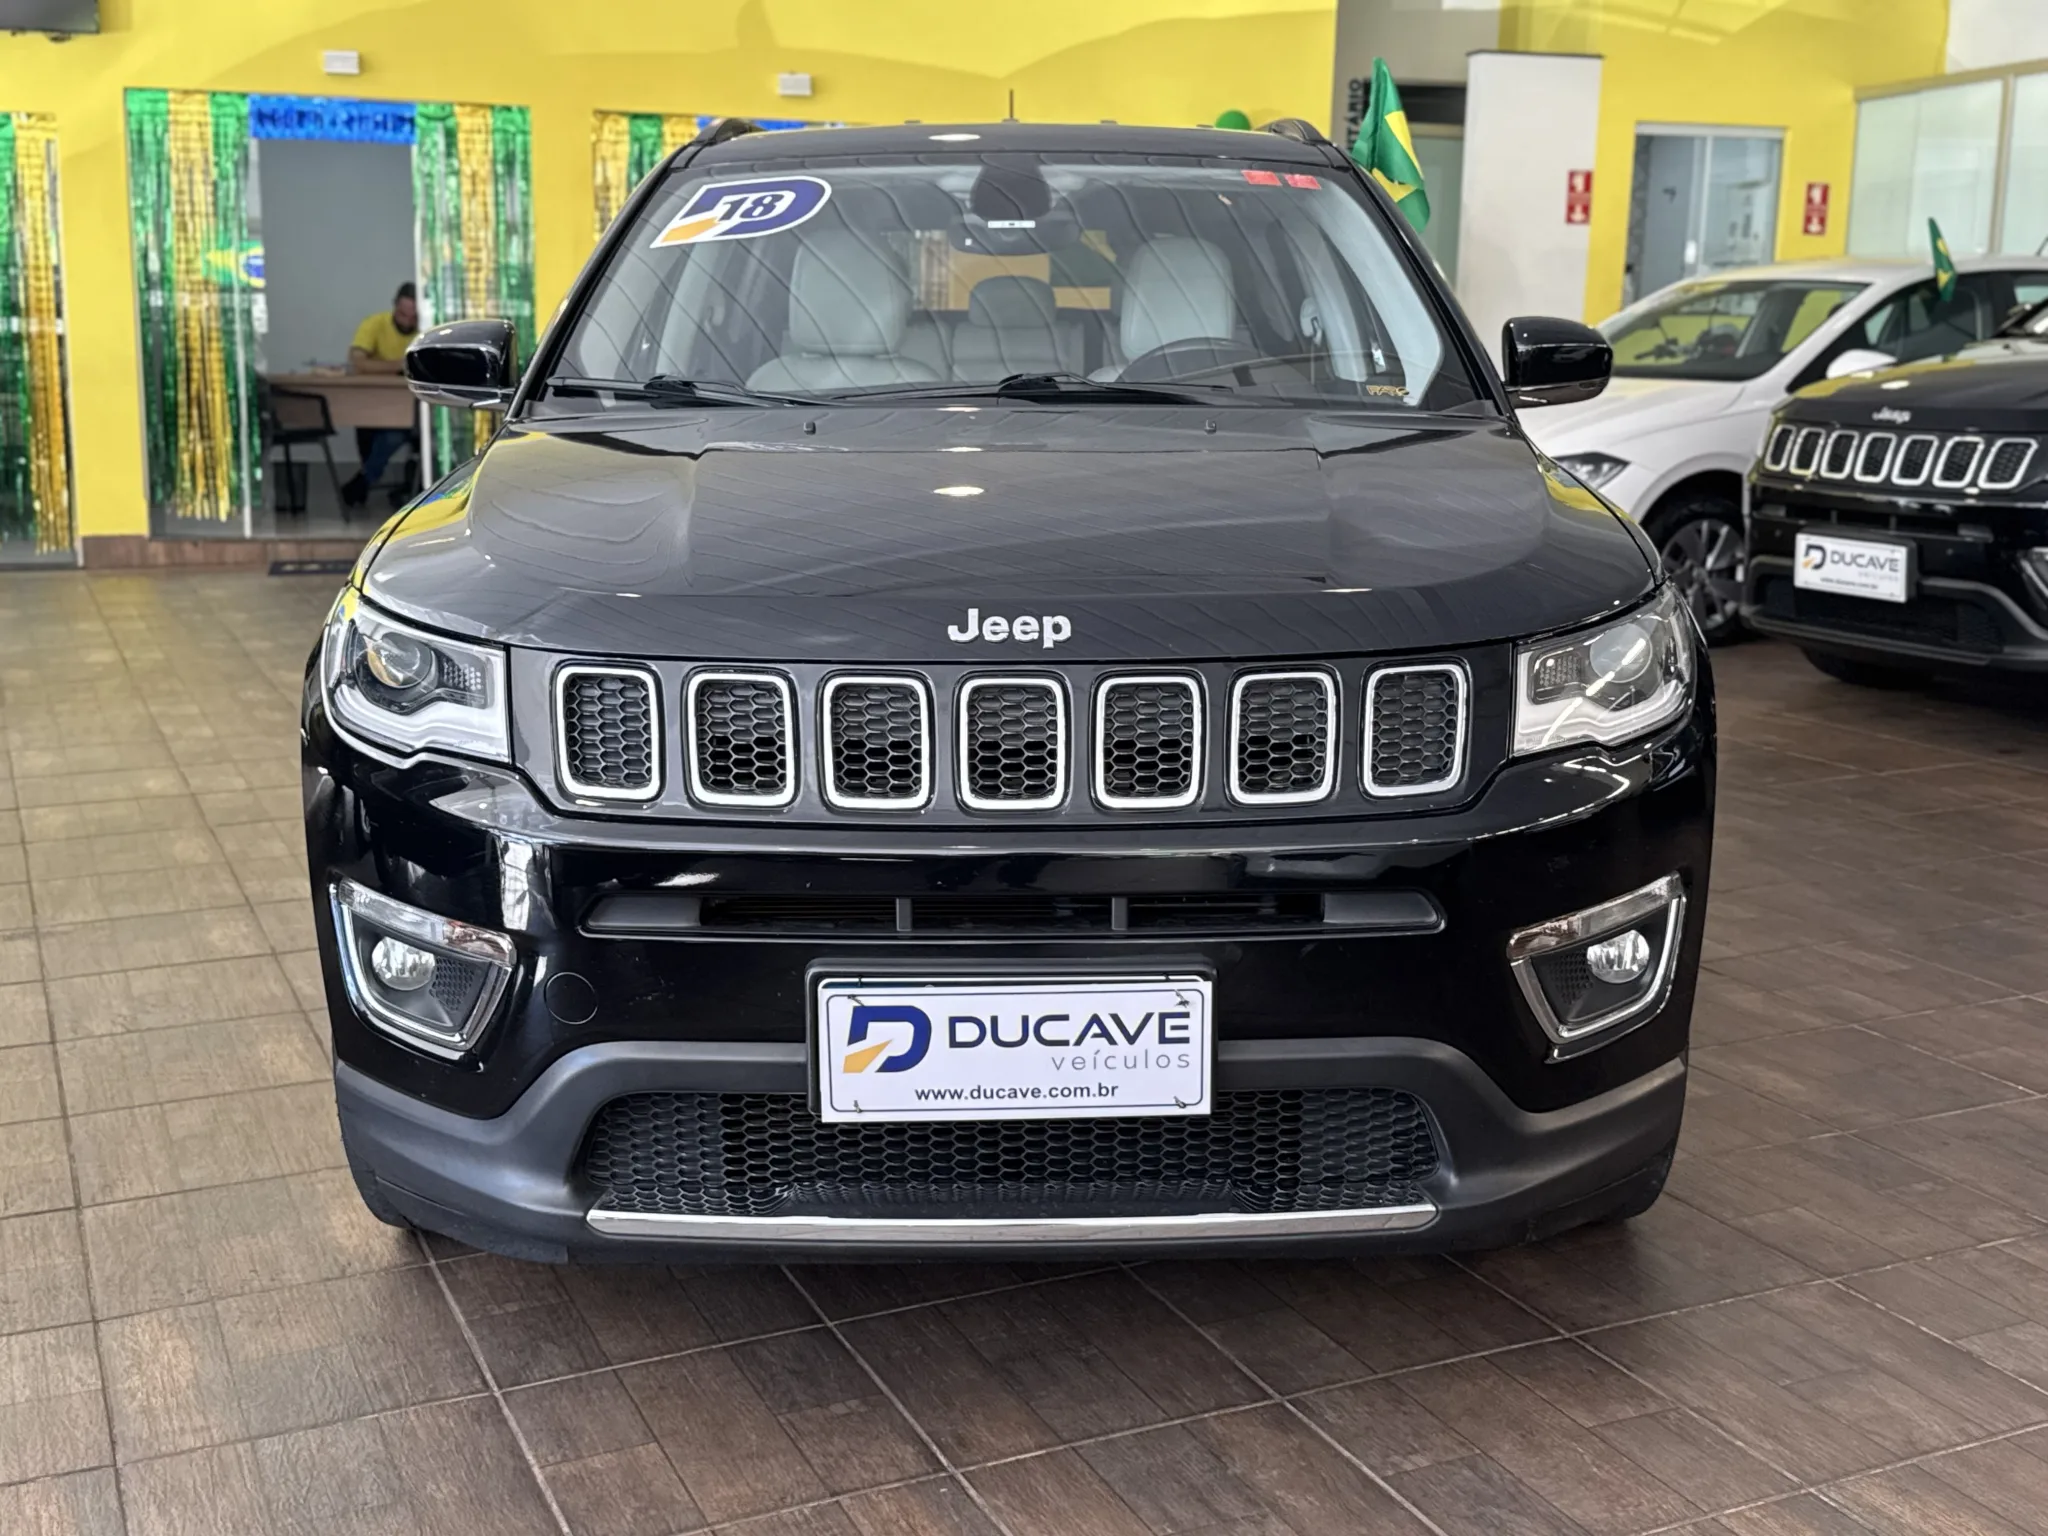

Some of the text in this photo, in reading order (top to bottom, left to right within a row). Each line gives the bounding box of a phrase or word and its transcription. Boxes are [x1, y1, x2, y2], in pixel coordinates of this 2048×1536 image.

[717, 193, 786, 222] 18
[1829, 549, 1900, 573] DUCAVE
[947, 607, 1072, 649] Jeep
[947, 1011, 1191, 1049] DUCAVE
[1051, 1049, 1191, 1072] veículos
[914, 1082, 1120, 1102] www.ducave.com.br
